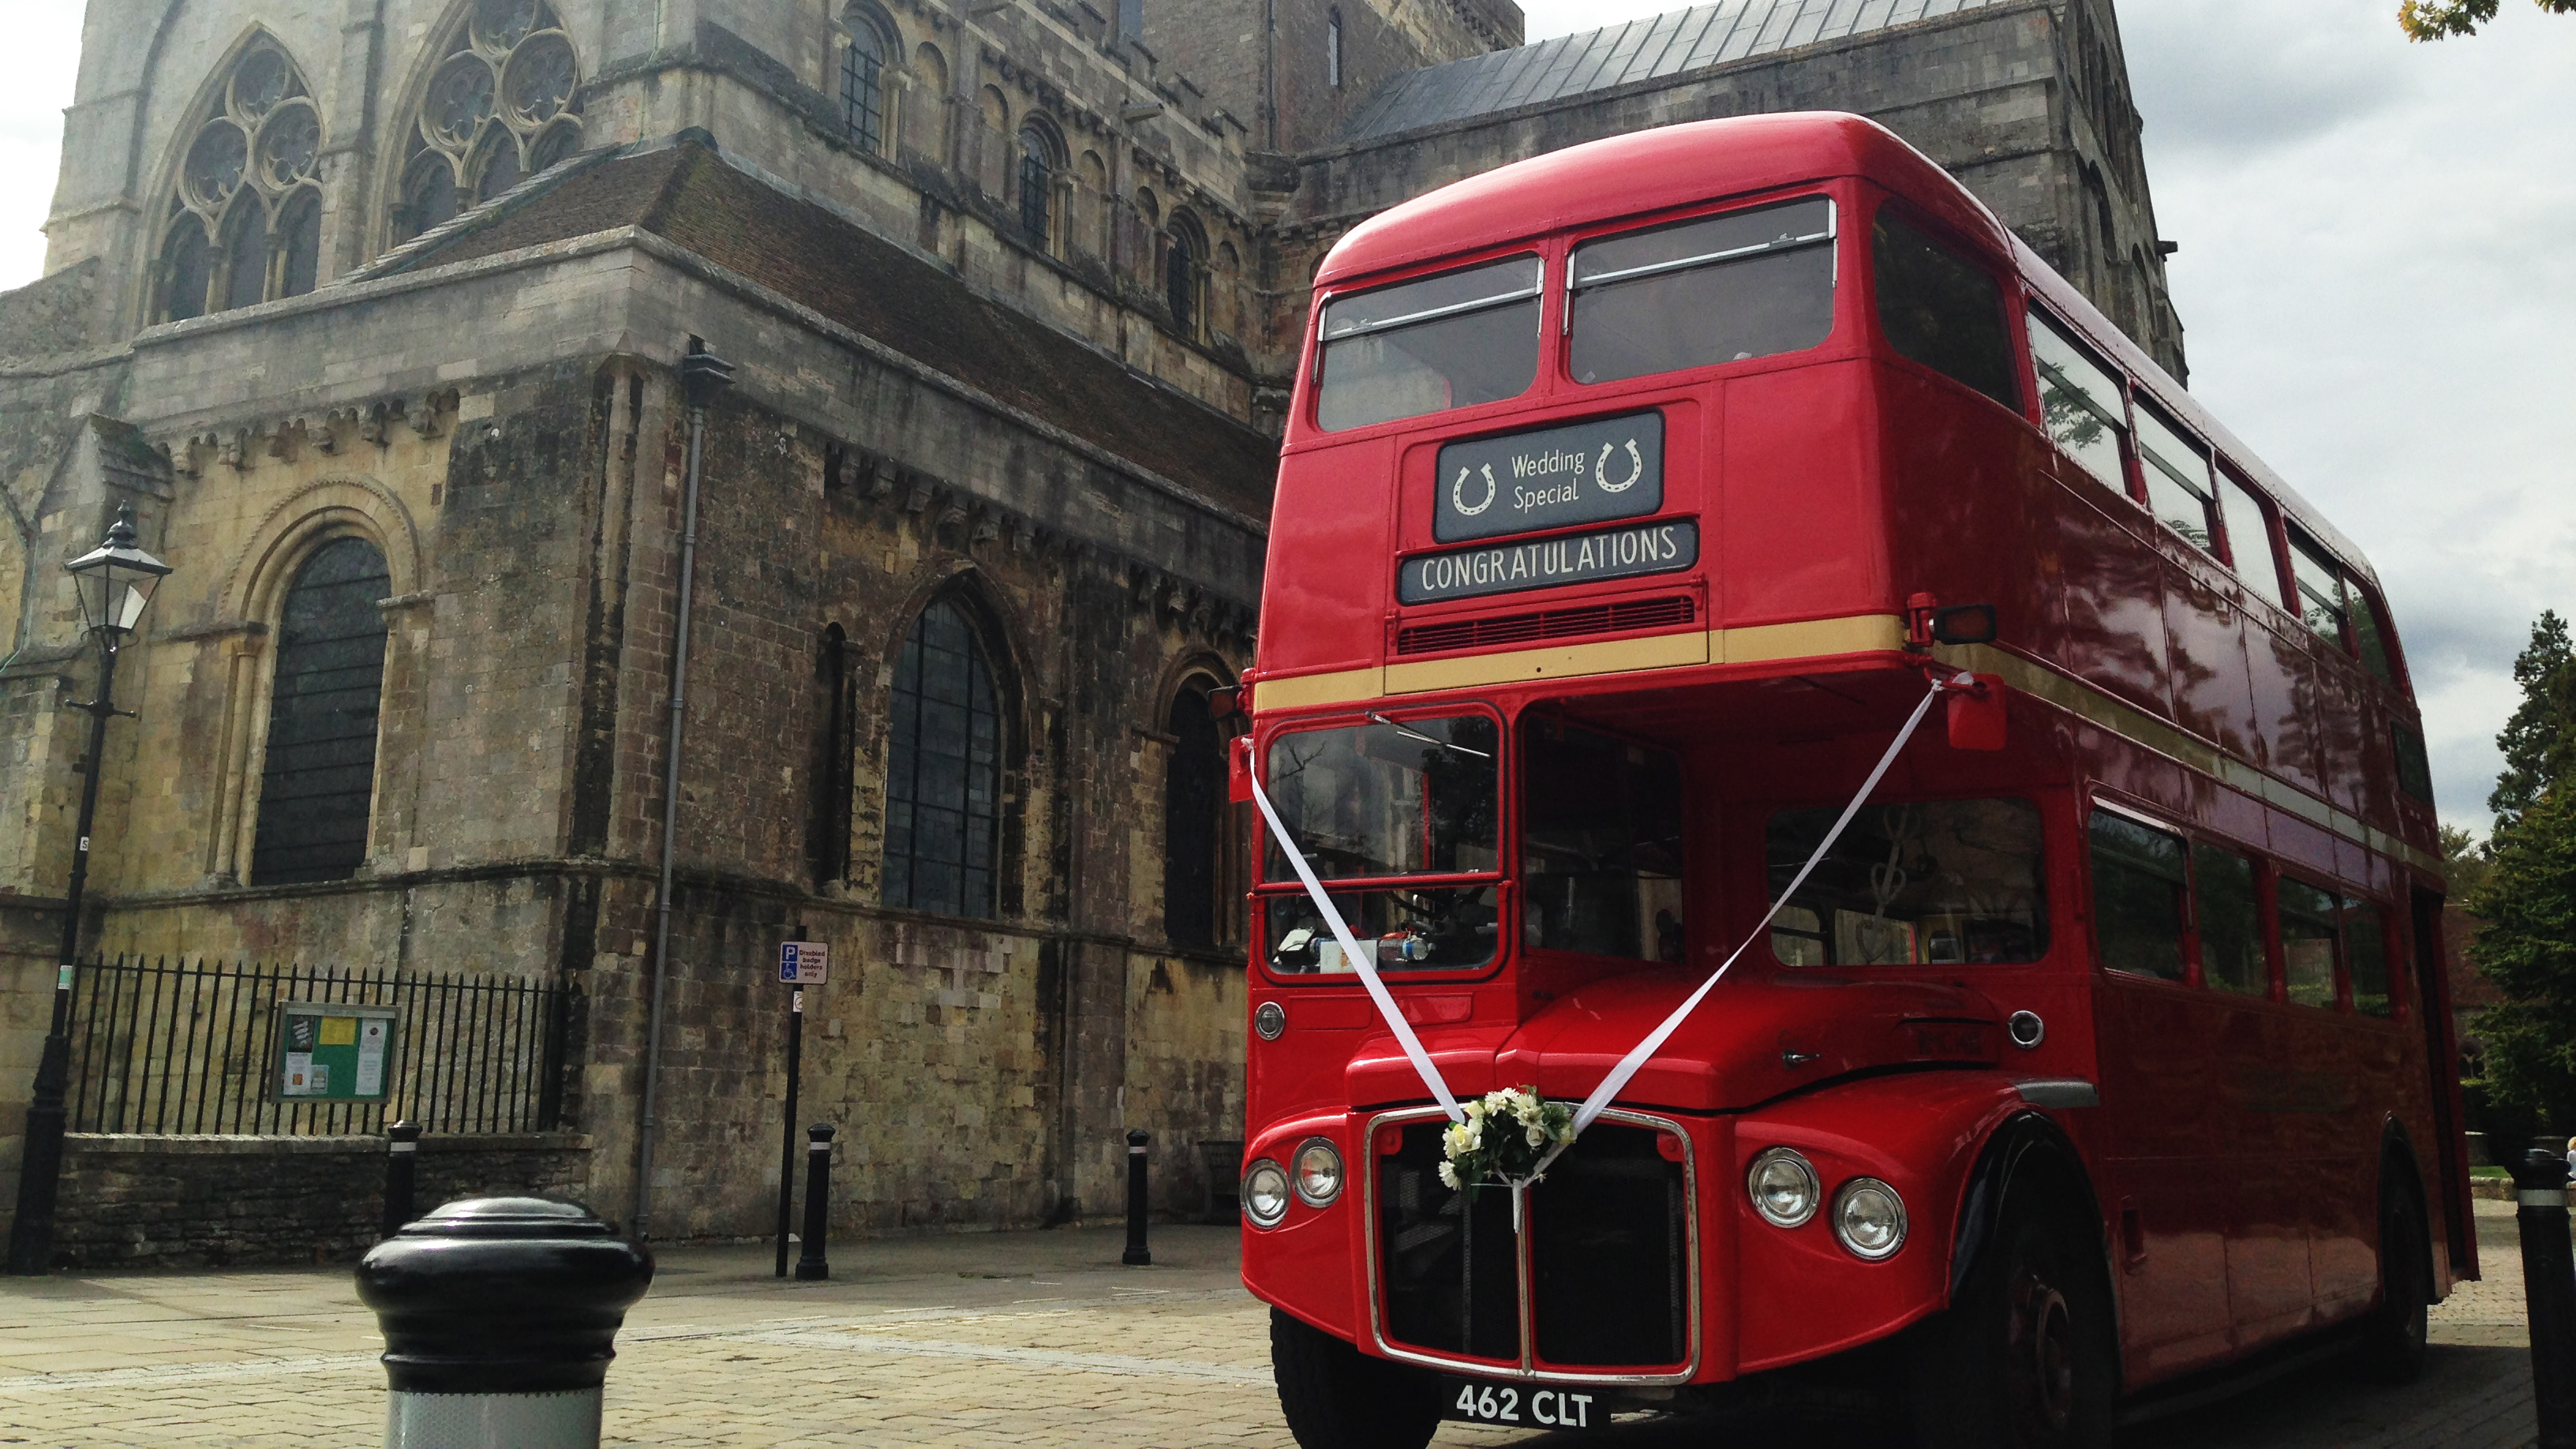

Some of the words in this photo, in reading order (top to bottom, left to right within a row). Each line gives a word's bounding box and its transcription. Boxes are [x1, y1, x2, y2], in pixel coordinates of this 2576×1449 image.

[1511, 447, 1586, 479] Wedding
[1514, 478, 1579, 514] Special
[1421, 525, 1678, 591] CONGRATULATIONS
[785, 946, 796, 960] P
[1456, 1384, 1519, 1421] 462
[1532, 1390, 1593, 1428] CLT
